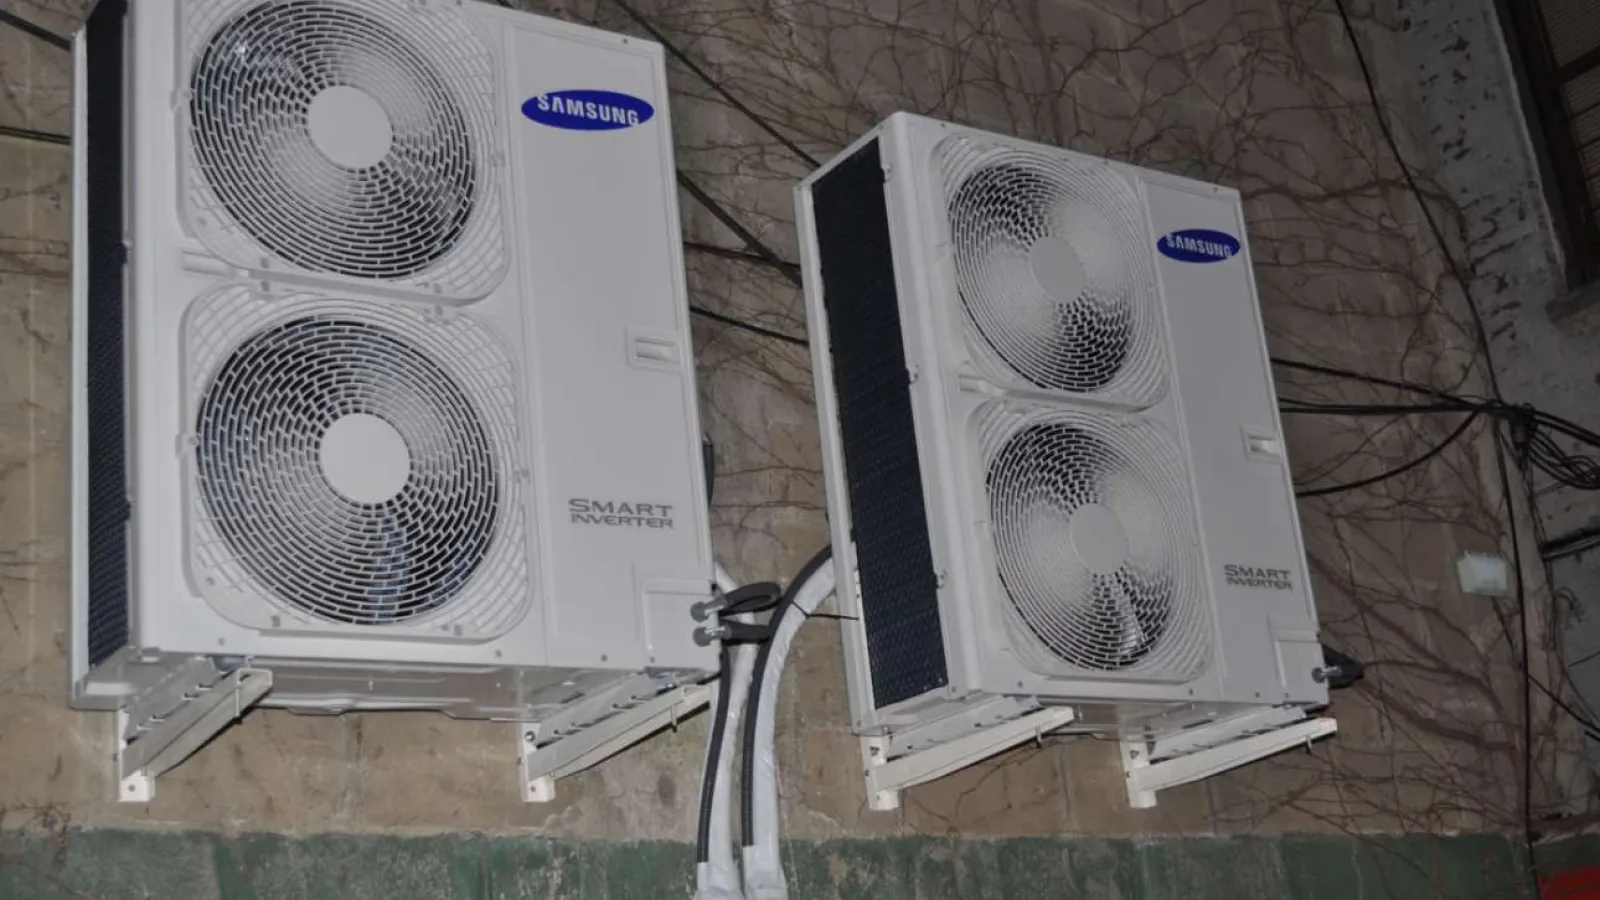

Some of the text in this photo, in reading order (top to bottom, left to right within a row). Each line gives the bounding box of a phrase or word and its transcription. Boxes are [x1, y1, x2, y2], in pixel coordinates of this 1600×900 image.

[537, 94, 639, 127] SAMSUNG
[1165, 232, 1232, 259] SAMSUNG
[568, 498, 673, 517] SMART
[570, 513, 674, 529] INVERTER
[1224, 564, 1291, 580] SMART
